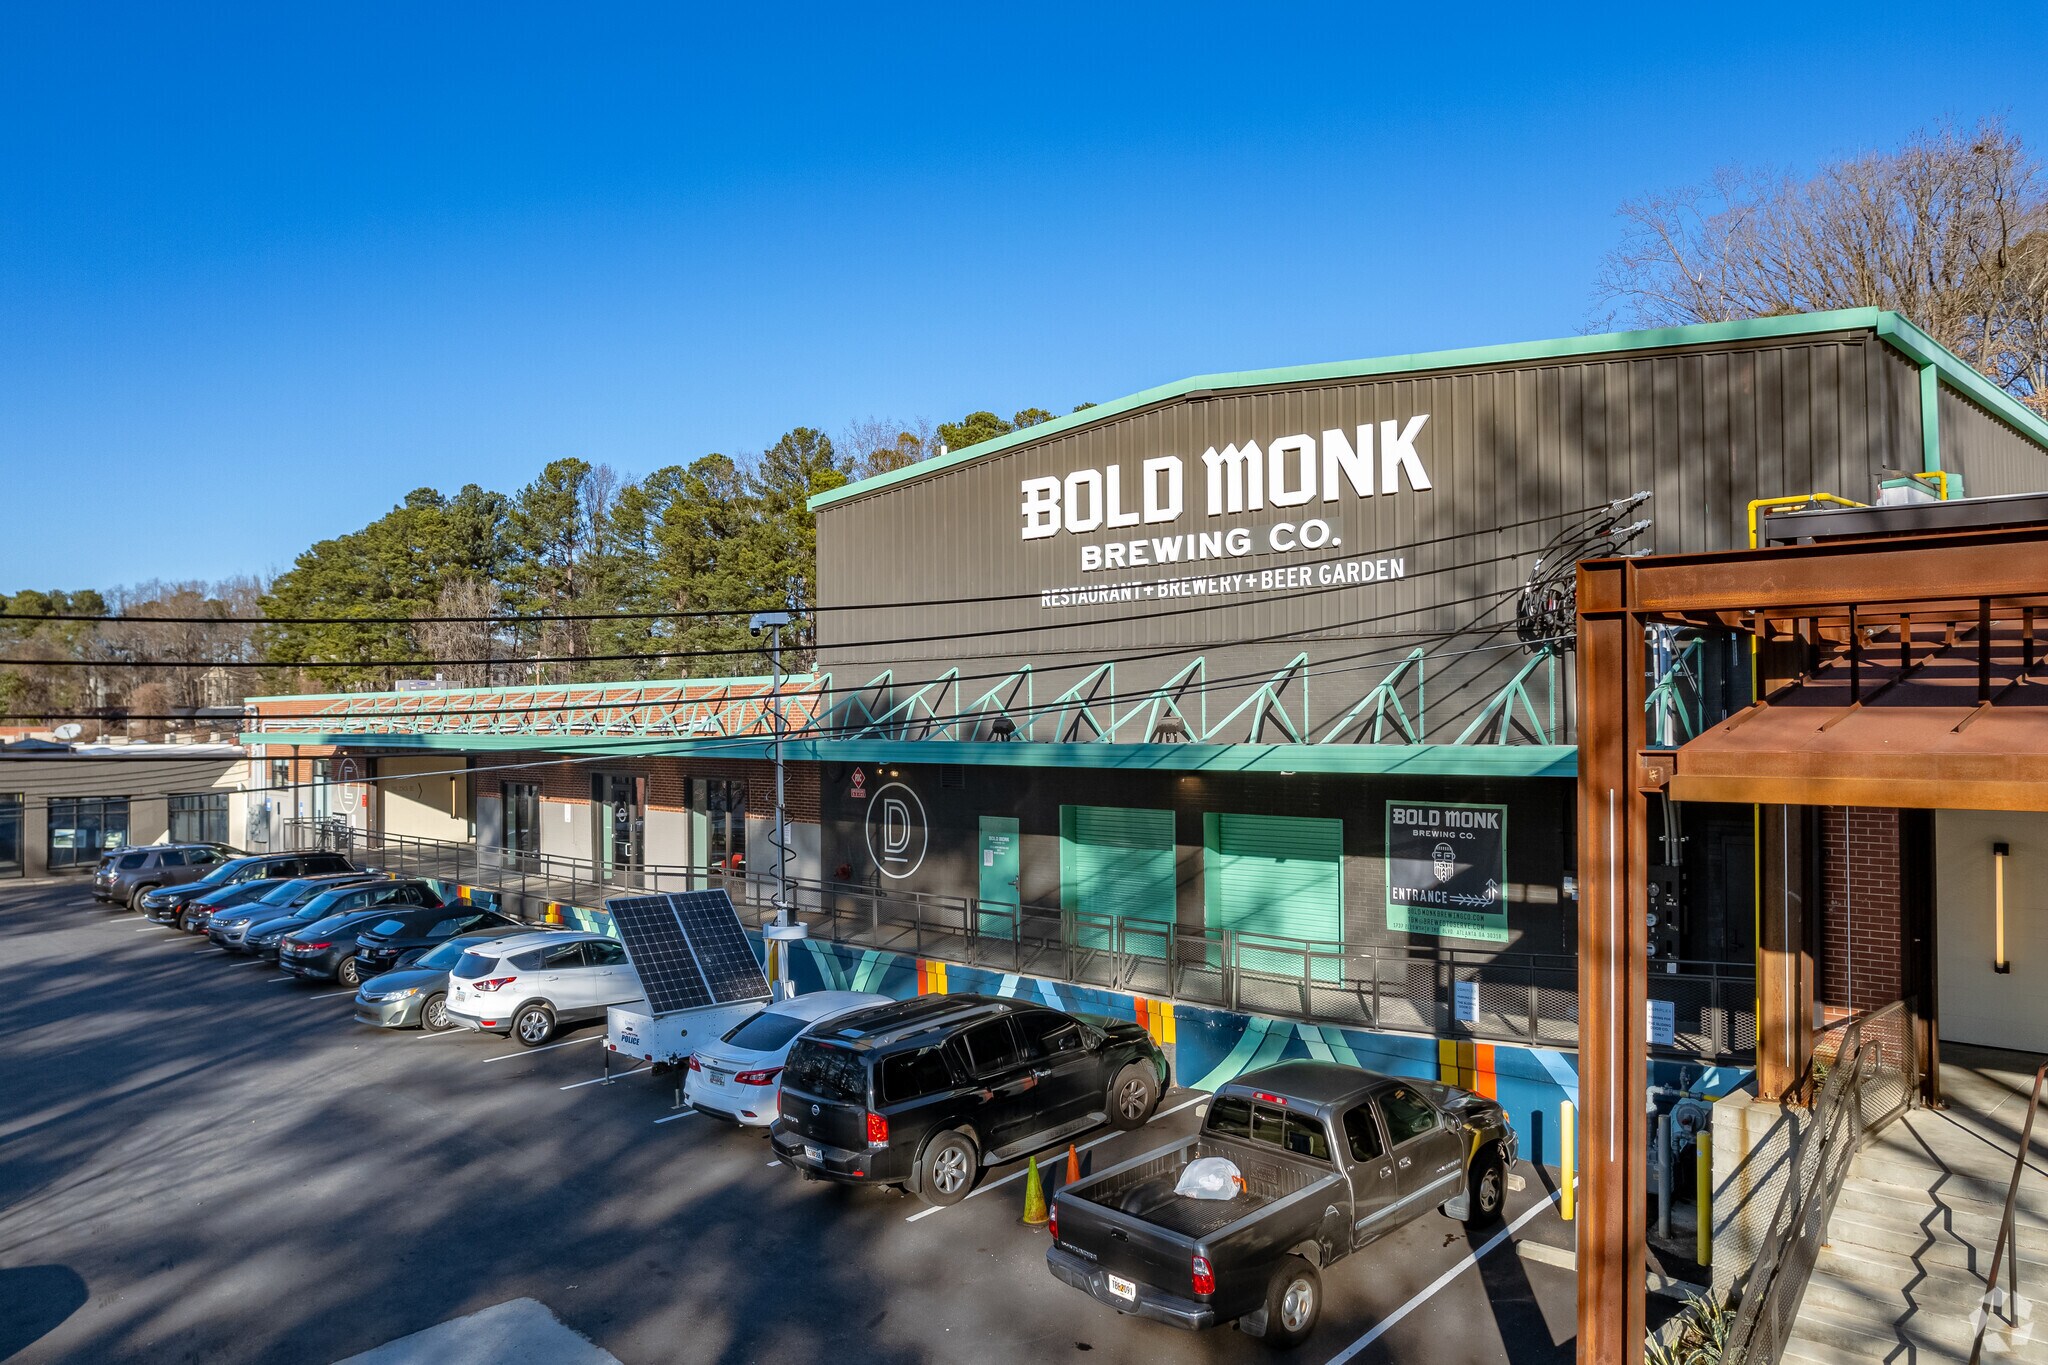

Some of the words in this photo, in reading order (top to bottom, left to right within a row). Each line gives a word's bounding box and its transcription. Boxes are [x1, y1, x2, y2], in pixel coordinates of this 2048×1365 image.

[1021, 455, 1183, 540] BOLD
[1201, 414, 1433, 516] MONK
[1081, 527, 1251, 571] BREWING
[1269, 519, 1342, 552] CO.
[1041, 580, 1142, 608] RESTAURANT
[1157, 574, 1243, 599] BREWERY
[1261, 566, 1312, 590] BEER
[1318, 558, 1405, 586] GARDEN
[1392, 808, 1440, 826] BOLD
[1445, 809, 1499, 829] MONK
[1412, 829, 1456, 839] BREWING
[1459, 832, 1476, 840] CO.
[1392, 887, 1448, 904] ENTRANCE
[621, 1034, 640, 1045] POLICE
